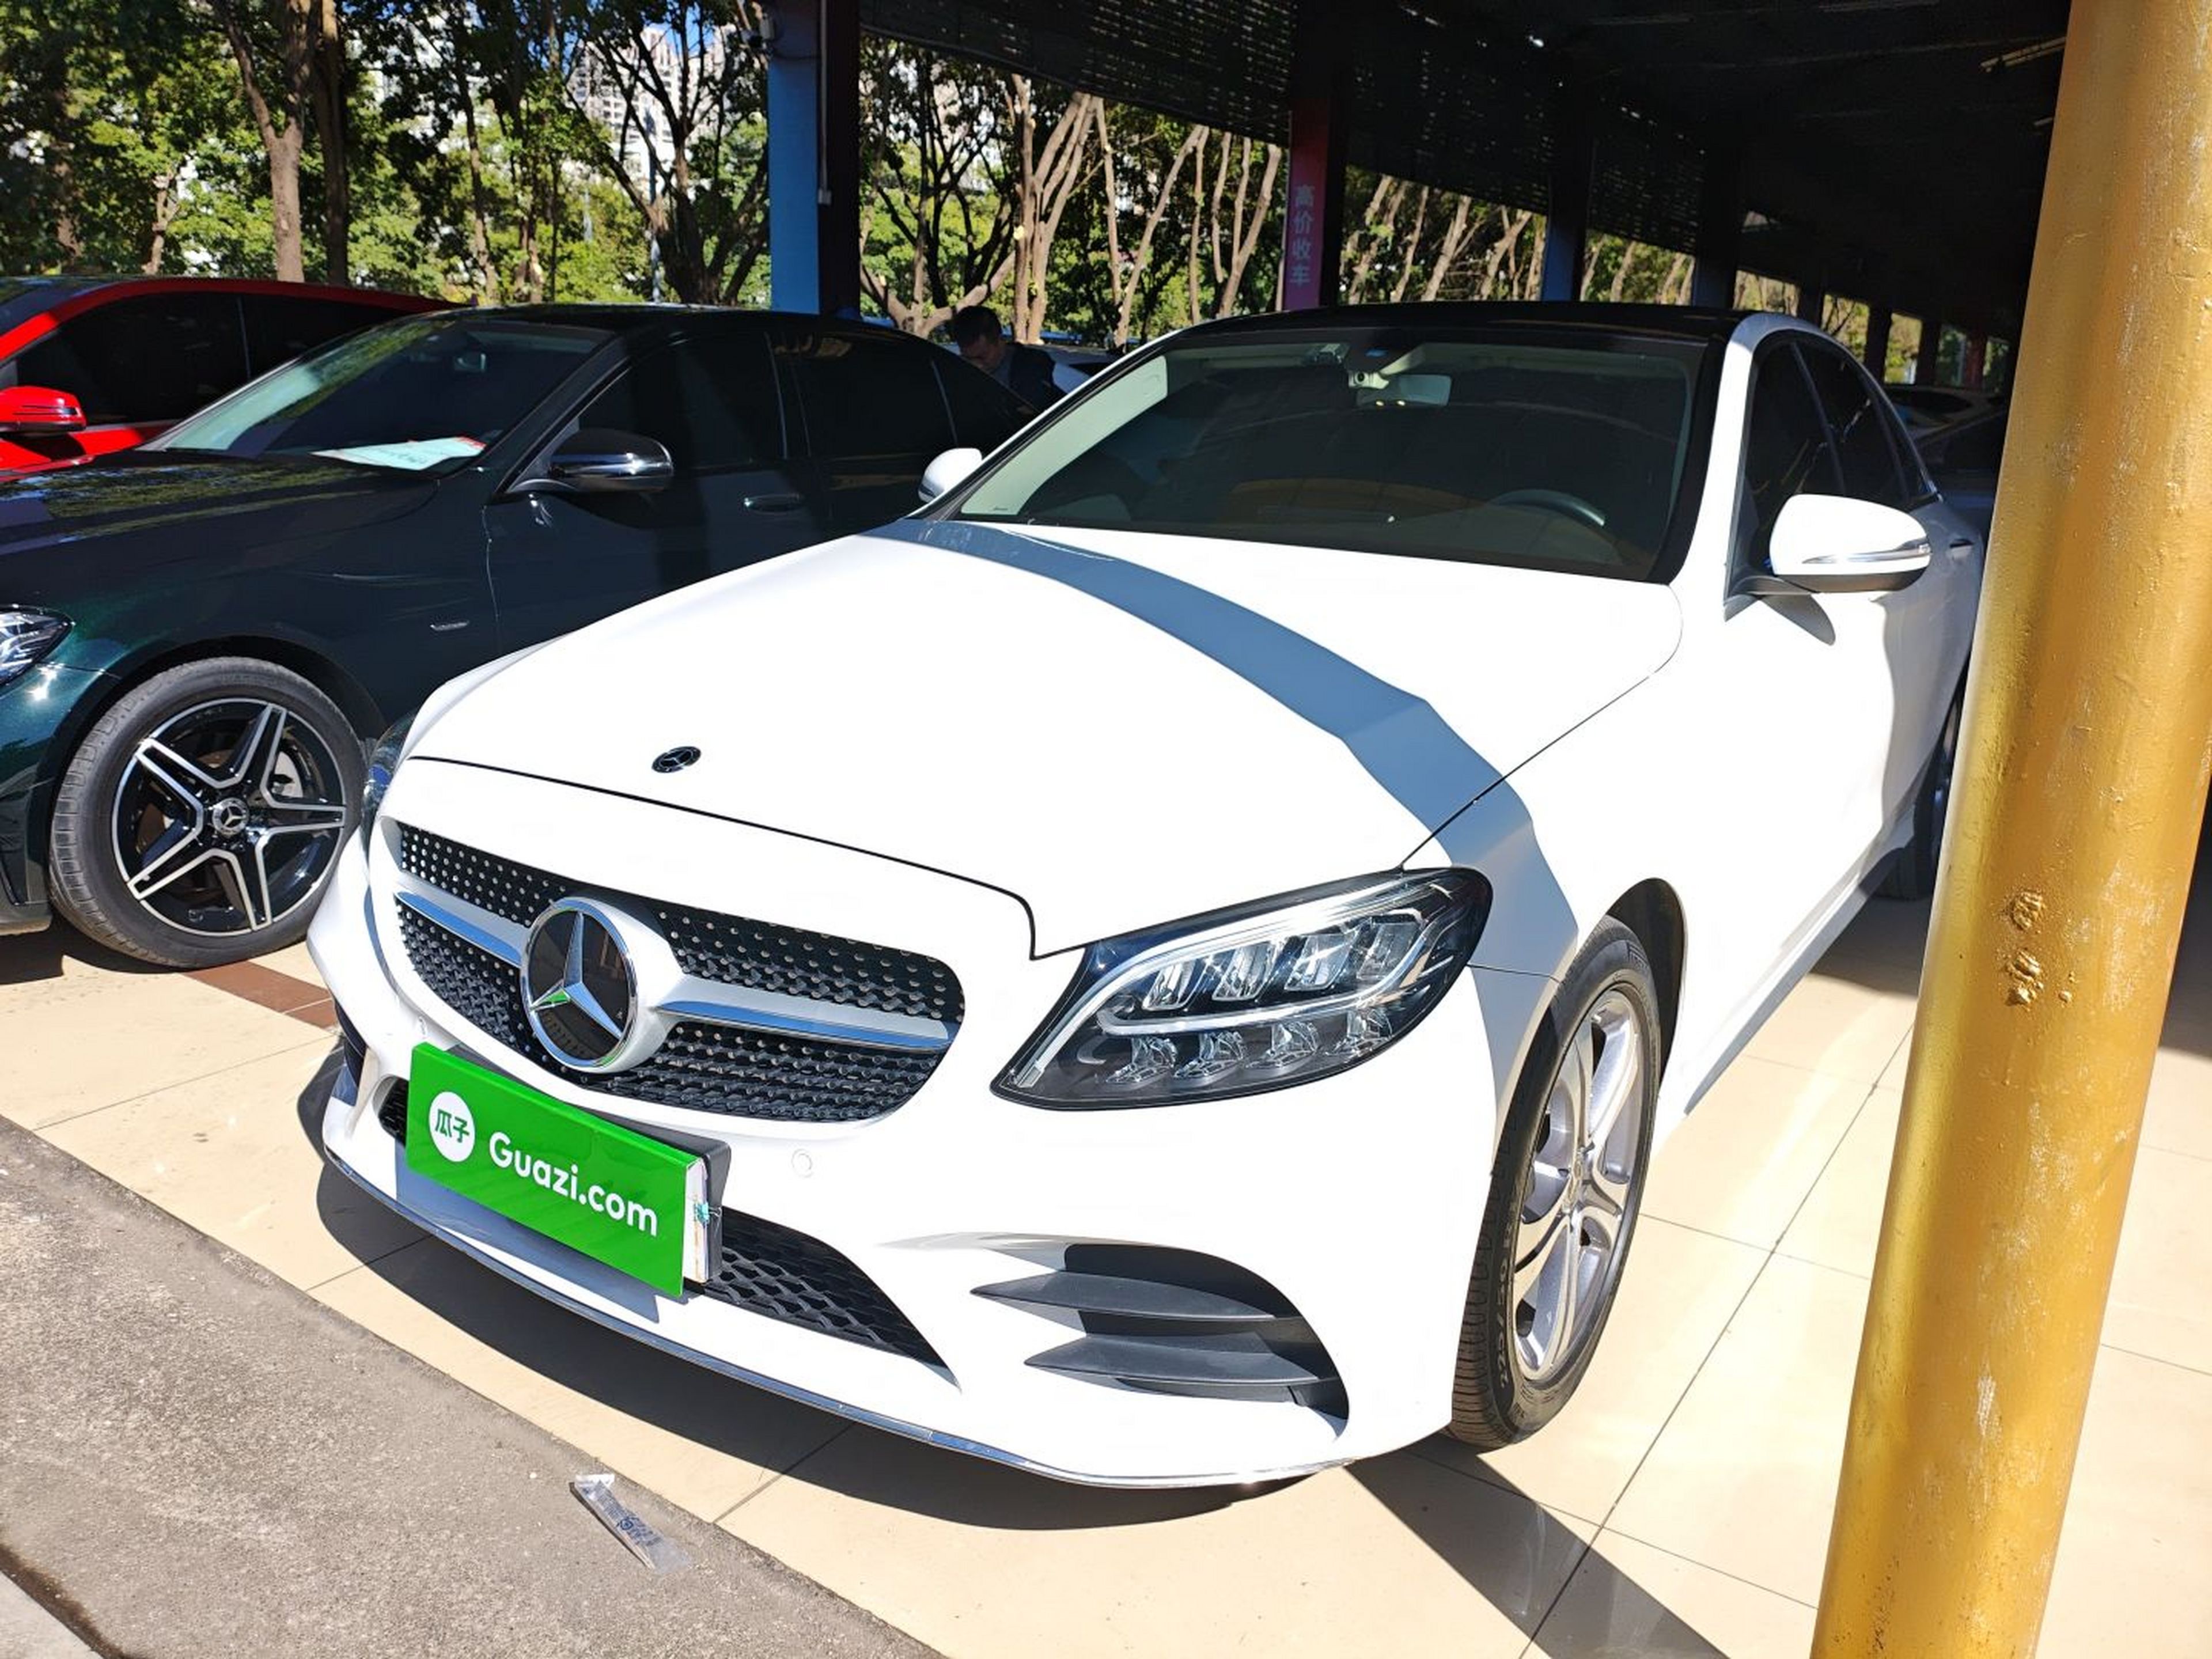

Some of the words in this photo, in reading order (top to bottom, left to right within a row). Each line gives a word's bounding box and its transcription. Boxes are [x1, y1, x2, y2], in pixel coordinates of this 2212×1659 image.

[1290, 184, 1315, 287] 高价收车
[435, 1109, 469, 1143] 瓜子
[489, 1131, 657, 1237] Guazi.com
